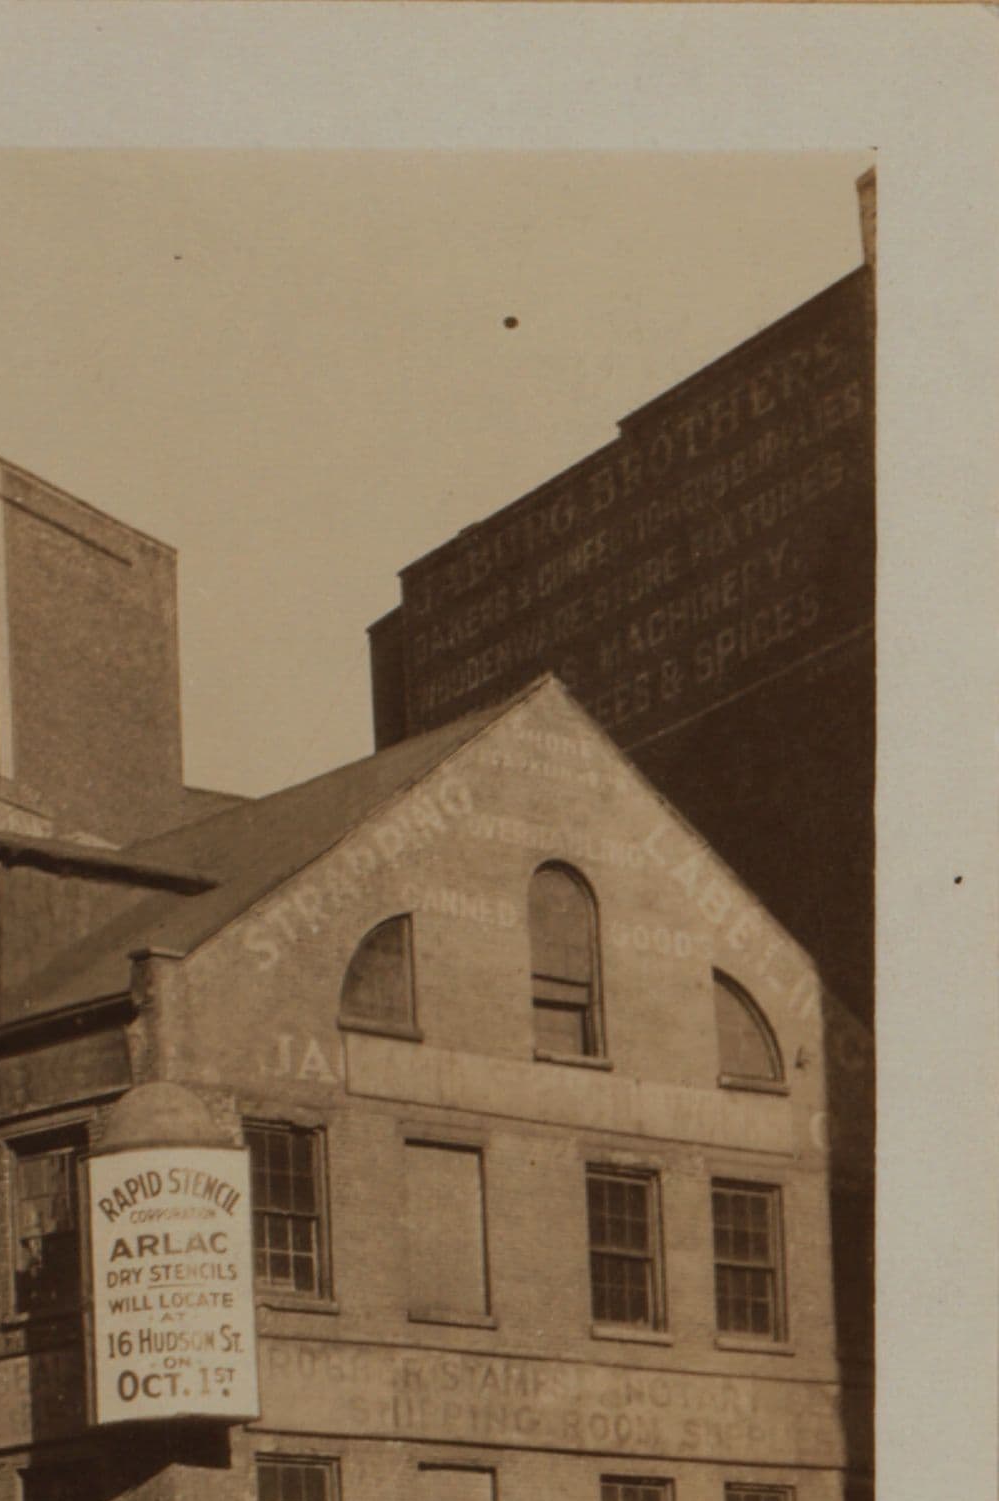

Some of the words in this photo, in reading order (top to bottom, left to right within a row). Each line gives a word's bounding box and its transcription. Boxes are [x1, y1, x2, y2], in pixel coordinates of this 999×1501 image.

[591, 331, 840, 514] BROTHERS
[694, 584, 819, 683] SPICES
[97, 1170, 163, 1223] RAPID
[168, 1167, 242, 1217] STENCIL
[109, 1231, 229, 1263] ARLAC
[106, 1267, 143, 1289] DRY
[150, 1261, 238, 1283] STENCILS
[109, 1294, 154, 1314] WILL
[159, 1292, 234, 1309] LOCATE
[107, 1330, 133, 1359] 16
[138, 1327, 215, 1354] HUDSON
[117, 1369, 191, 1402] OCT.
